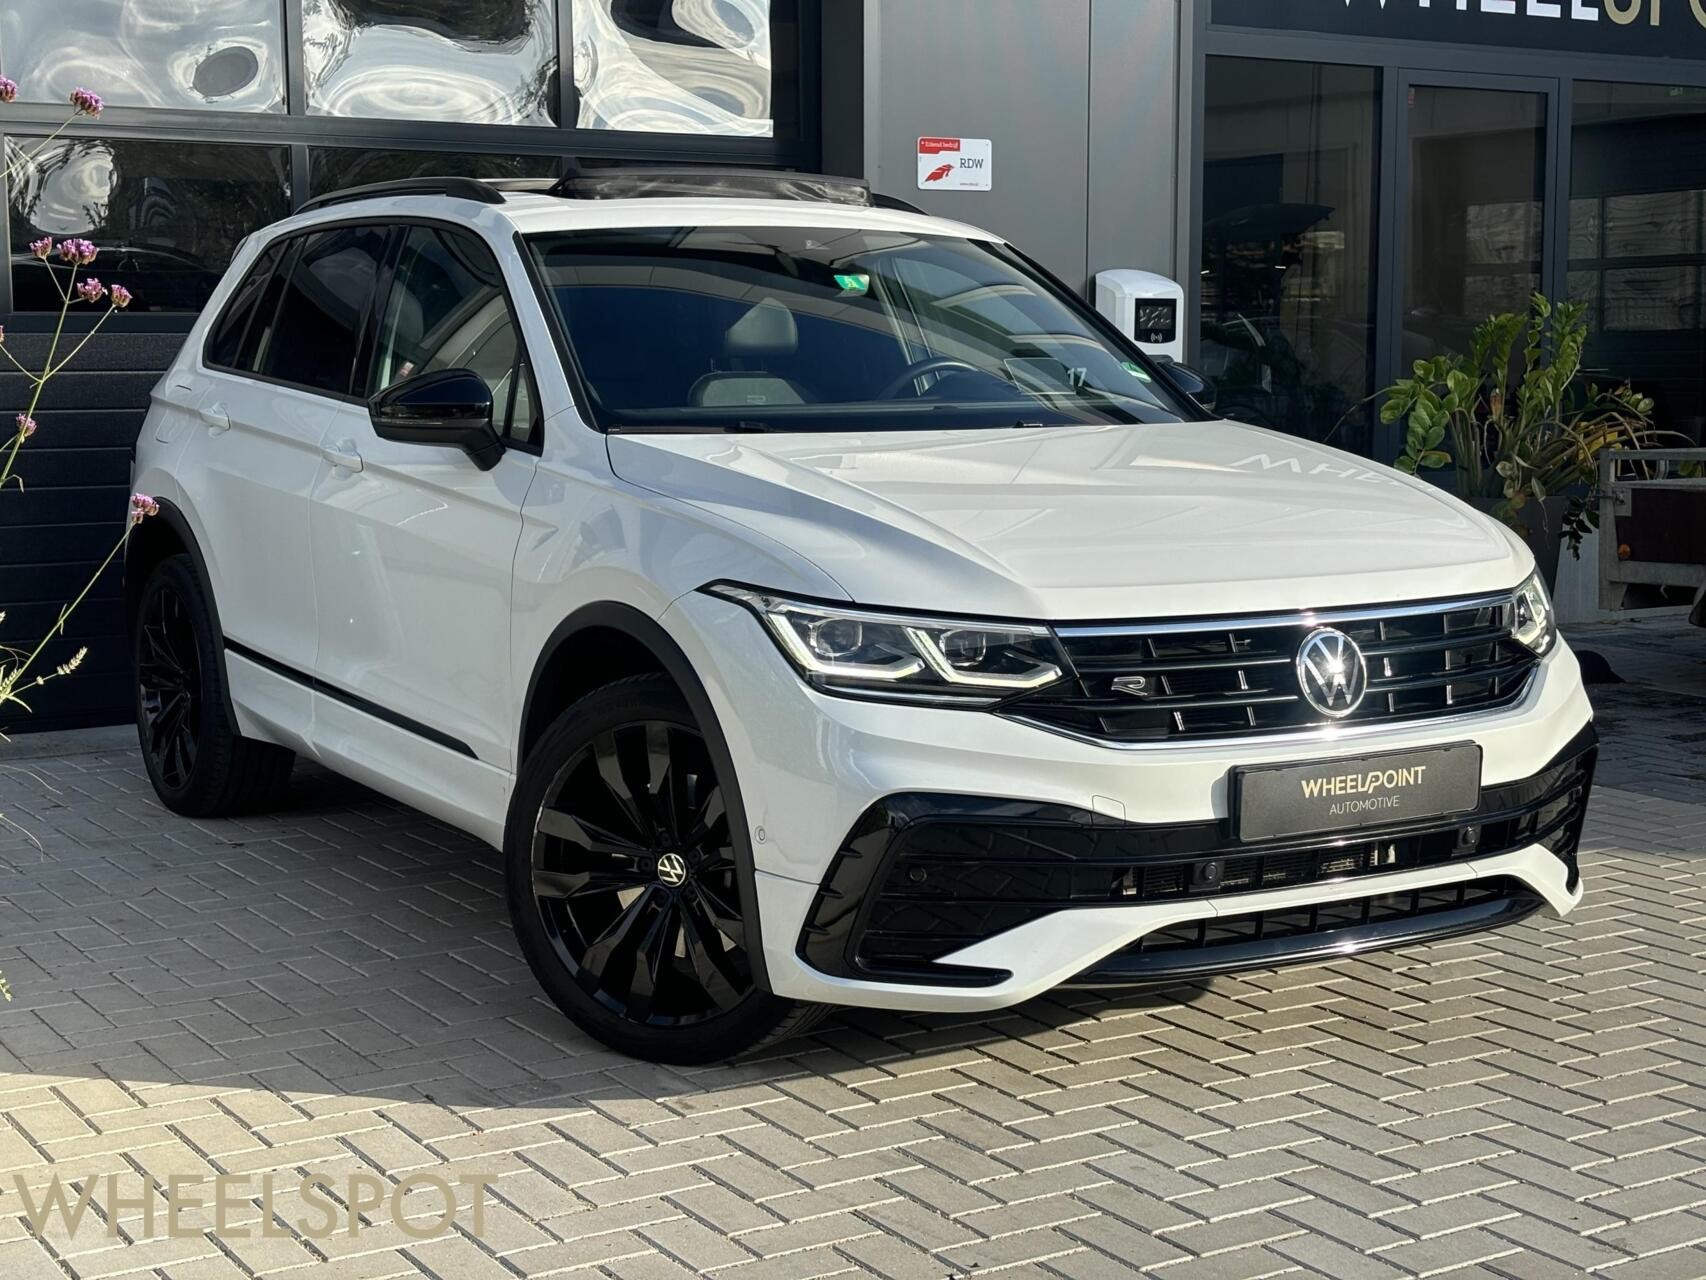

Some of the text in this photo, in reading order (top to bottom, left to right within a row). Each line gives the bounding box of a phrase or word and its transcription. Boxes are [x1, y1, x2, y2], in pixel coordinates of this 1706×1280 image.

[959, 158, 984, 169] RDW
[1067, 367, 1088, 387] 17
[1111, 676, 1148, 696] R
[1300, 765, 1427, 799] WHEELPOINT
[1328, 795, 1401, 816] AUTOMOTIVE
